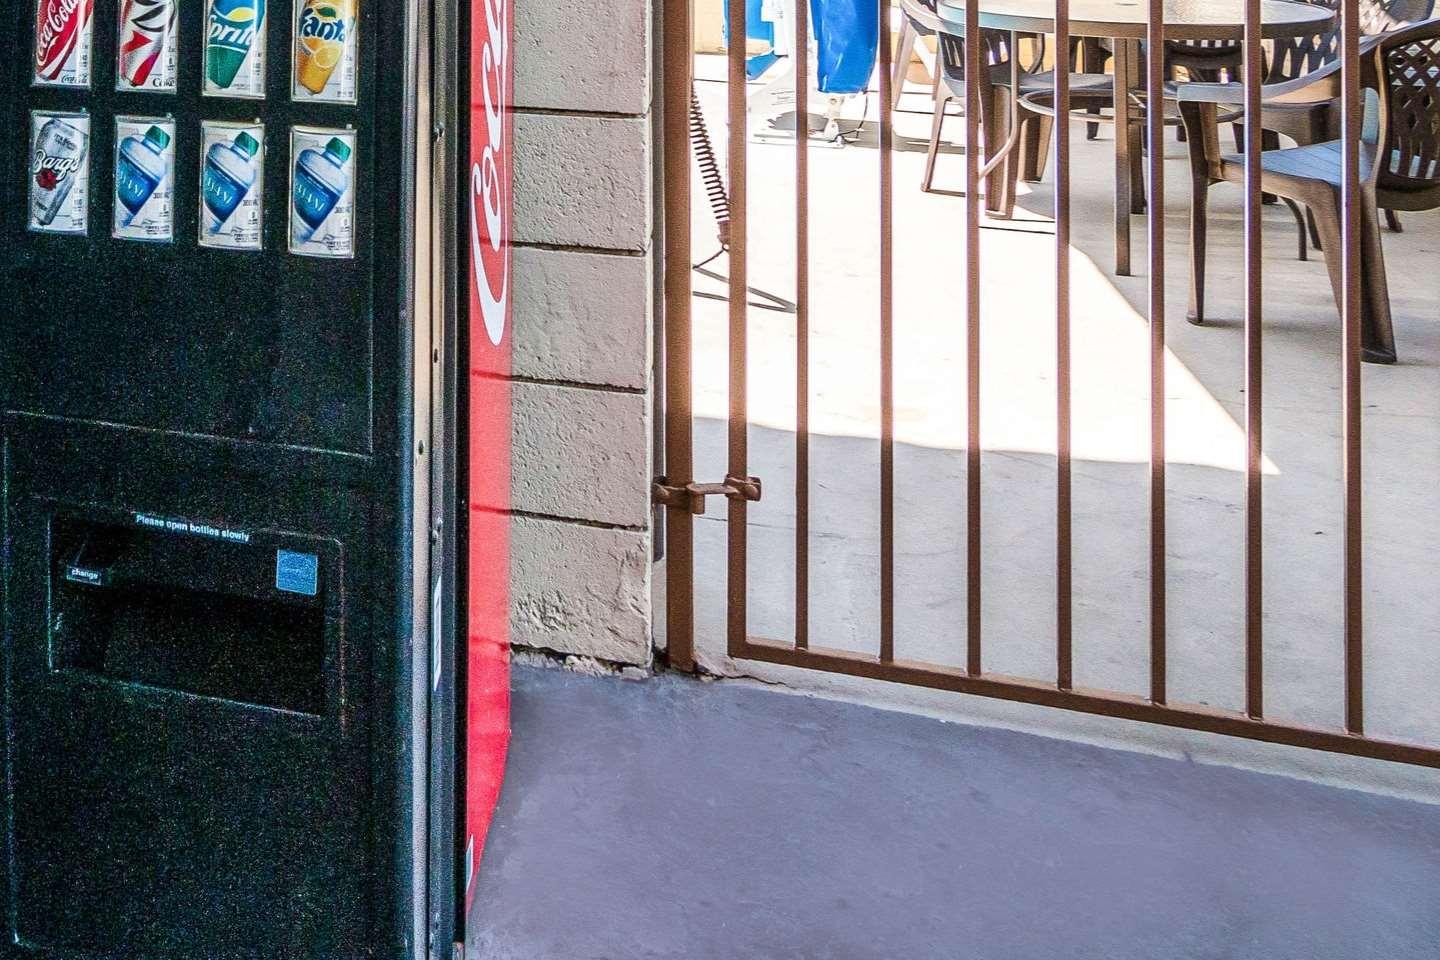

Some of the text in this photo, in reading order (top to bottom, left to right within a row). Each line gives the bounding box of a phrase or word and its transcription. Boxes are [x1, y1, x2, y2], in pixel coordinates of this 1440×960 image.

[136, 514, 250, 542] Please open bottles slowly
[71, 568, 98, 580] change
